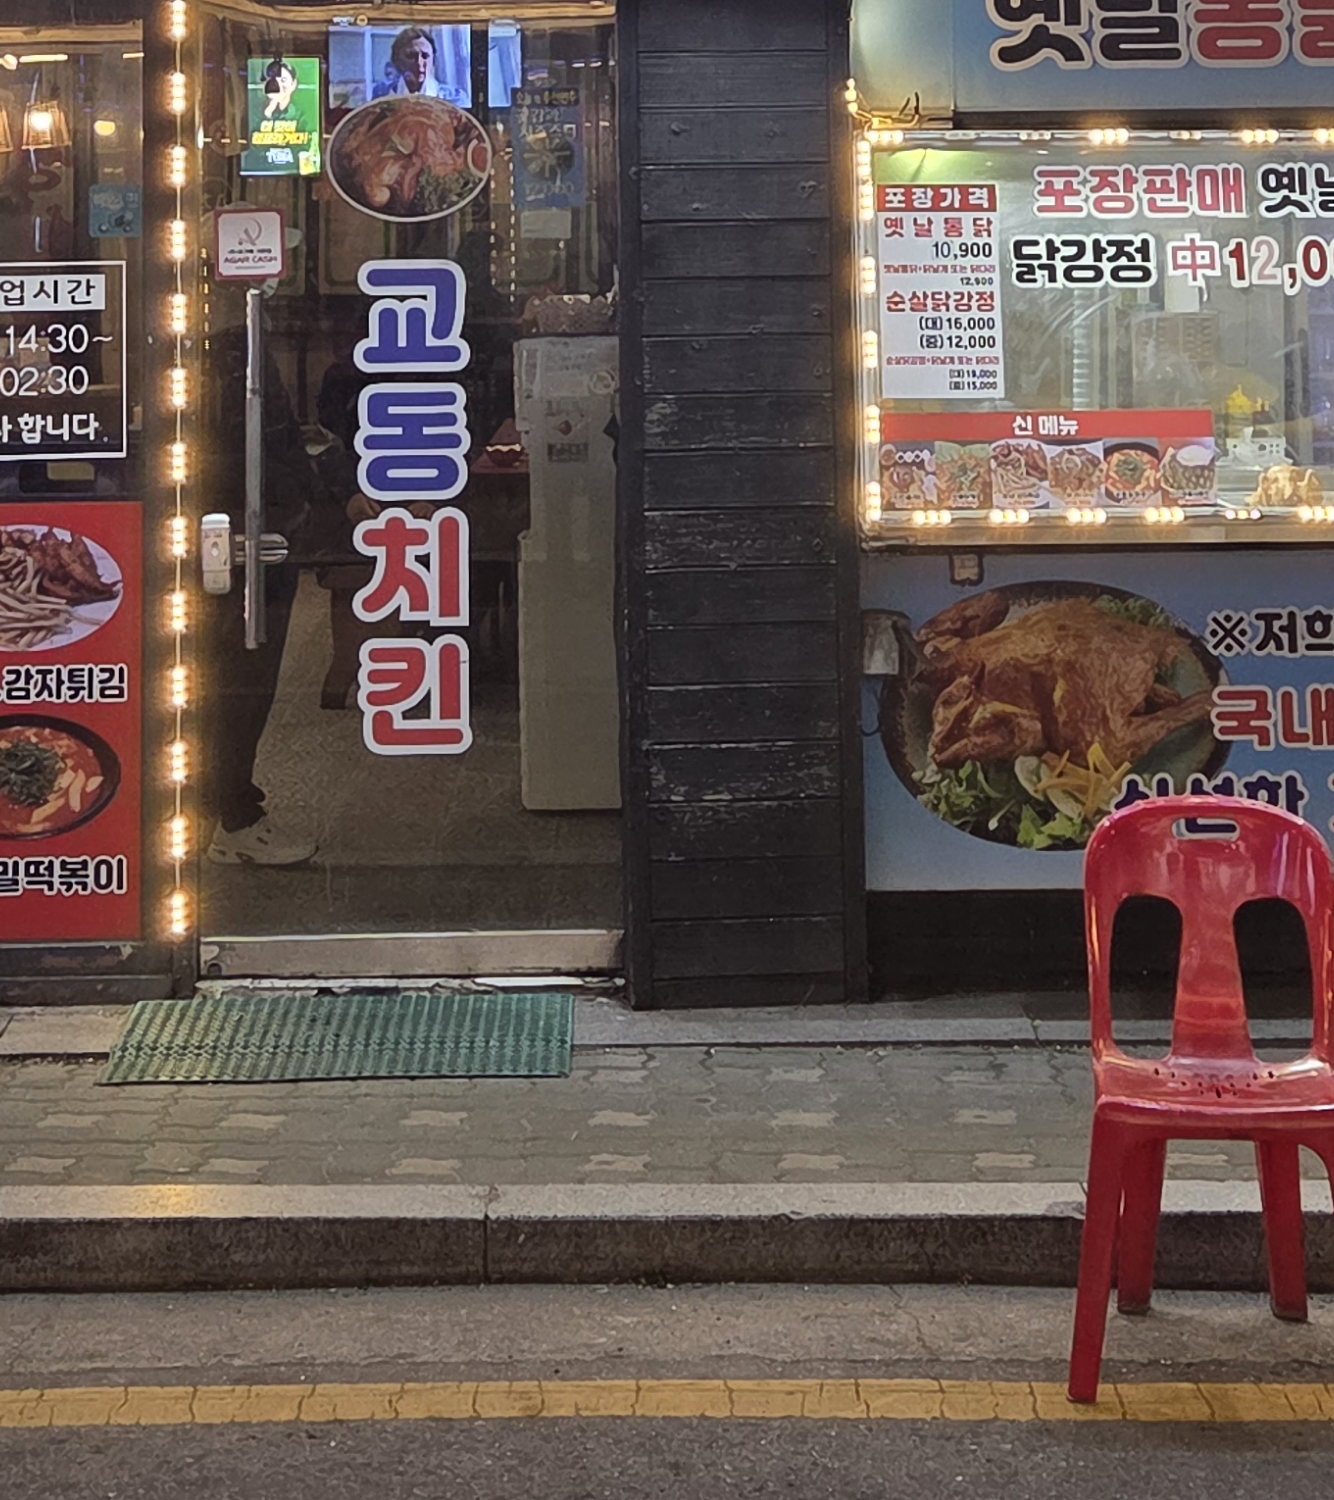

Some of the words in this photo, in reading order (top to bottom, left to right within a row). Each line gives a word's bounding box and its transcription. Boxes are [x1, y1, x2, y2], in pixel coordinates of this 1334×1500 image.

[884, 187, 990, 208] 포장가격
[1032, 162, 1248, 219] 포장판매
[931, 240, 993, 260] 10,900
[1010, 232, 1156, 289] 닭강정
[886, 290, 996, 313] 순살닭강정
[352, 259, 472, 756] 교동치킨
